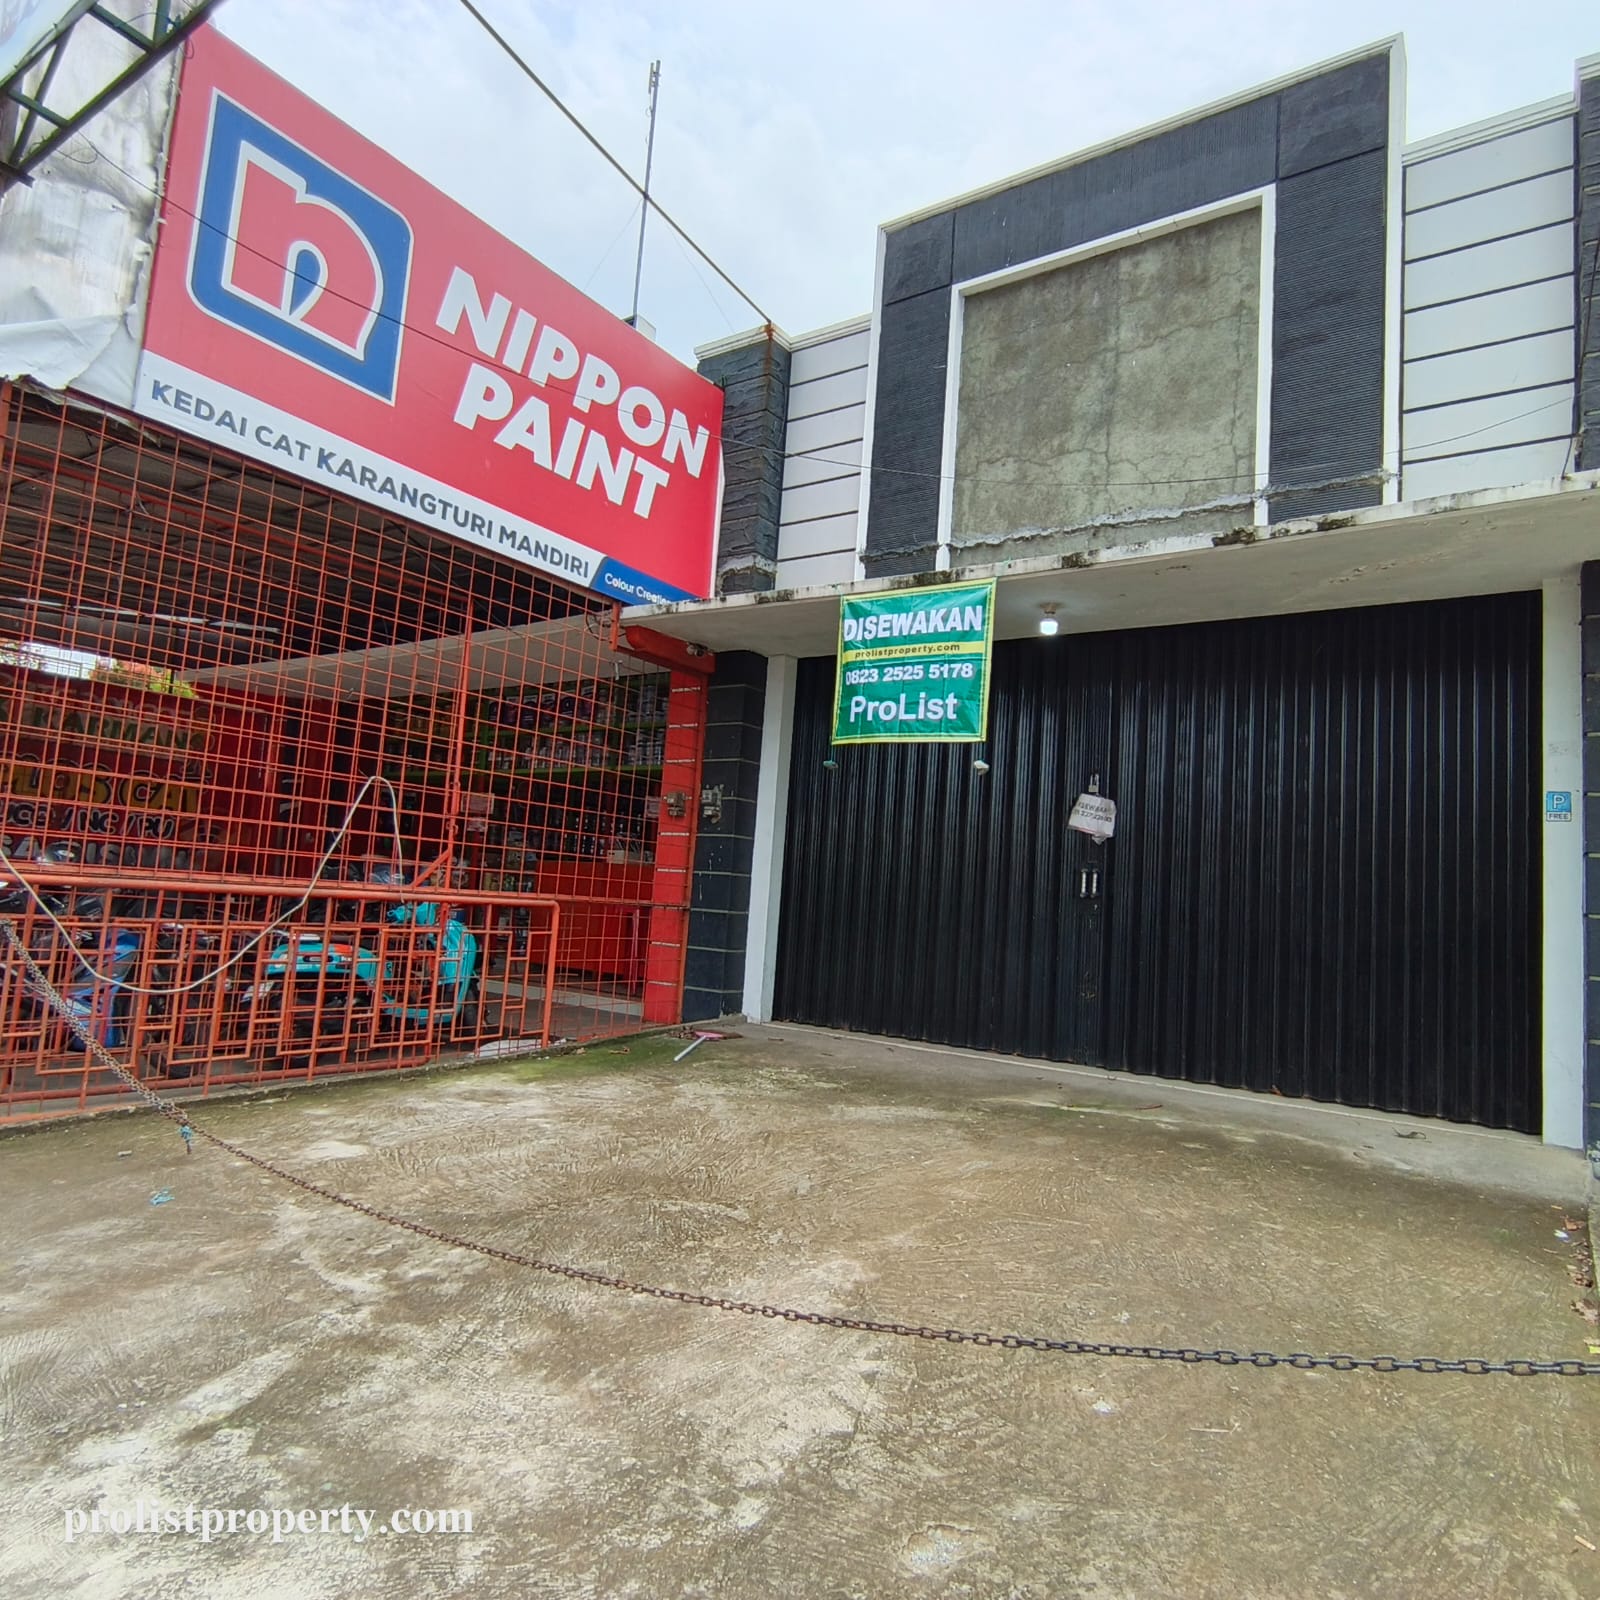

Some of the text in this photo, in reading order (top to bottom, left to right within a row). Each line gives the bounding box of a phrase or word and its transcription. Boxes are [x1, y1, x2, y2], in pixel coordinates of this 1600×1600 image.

[436, 265, 710, 479] NIPPON
[453, 362, 670, 520] PAINT
[151, 379, 589, 579] KEDAI CAT KARANGTURI MANDIRI
[604, 572, 635, 593] Colour
[843, 605, 983, 642] DISEWAKAN
[855, 643, 960, 659] prolistproperty.com
[845, 662, 974, 686] 0823 2525 5178
[849, 691, 958, 723] ProList
[1553, 795, 1565, 809] P
